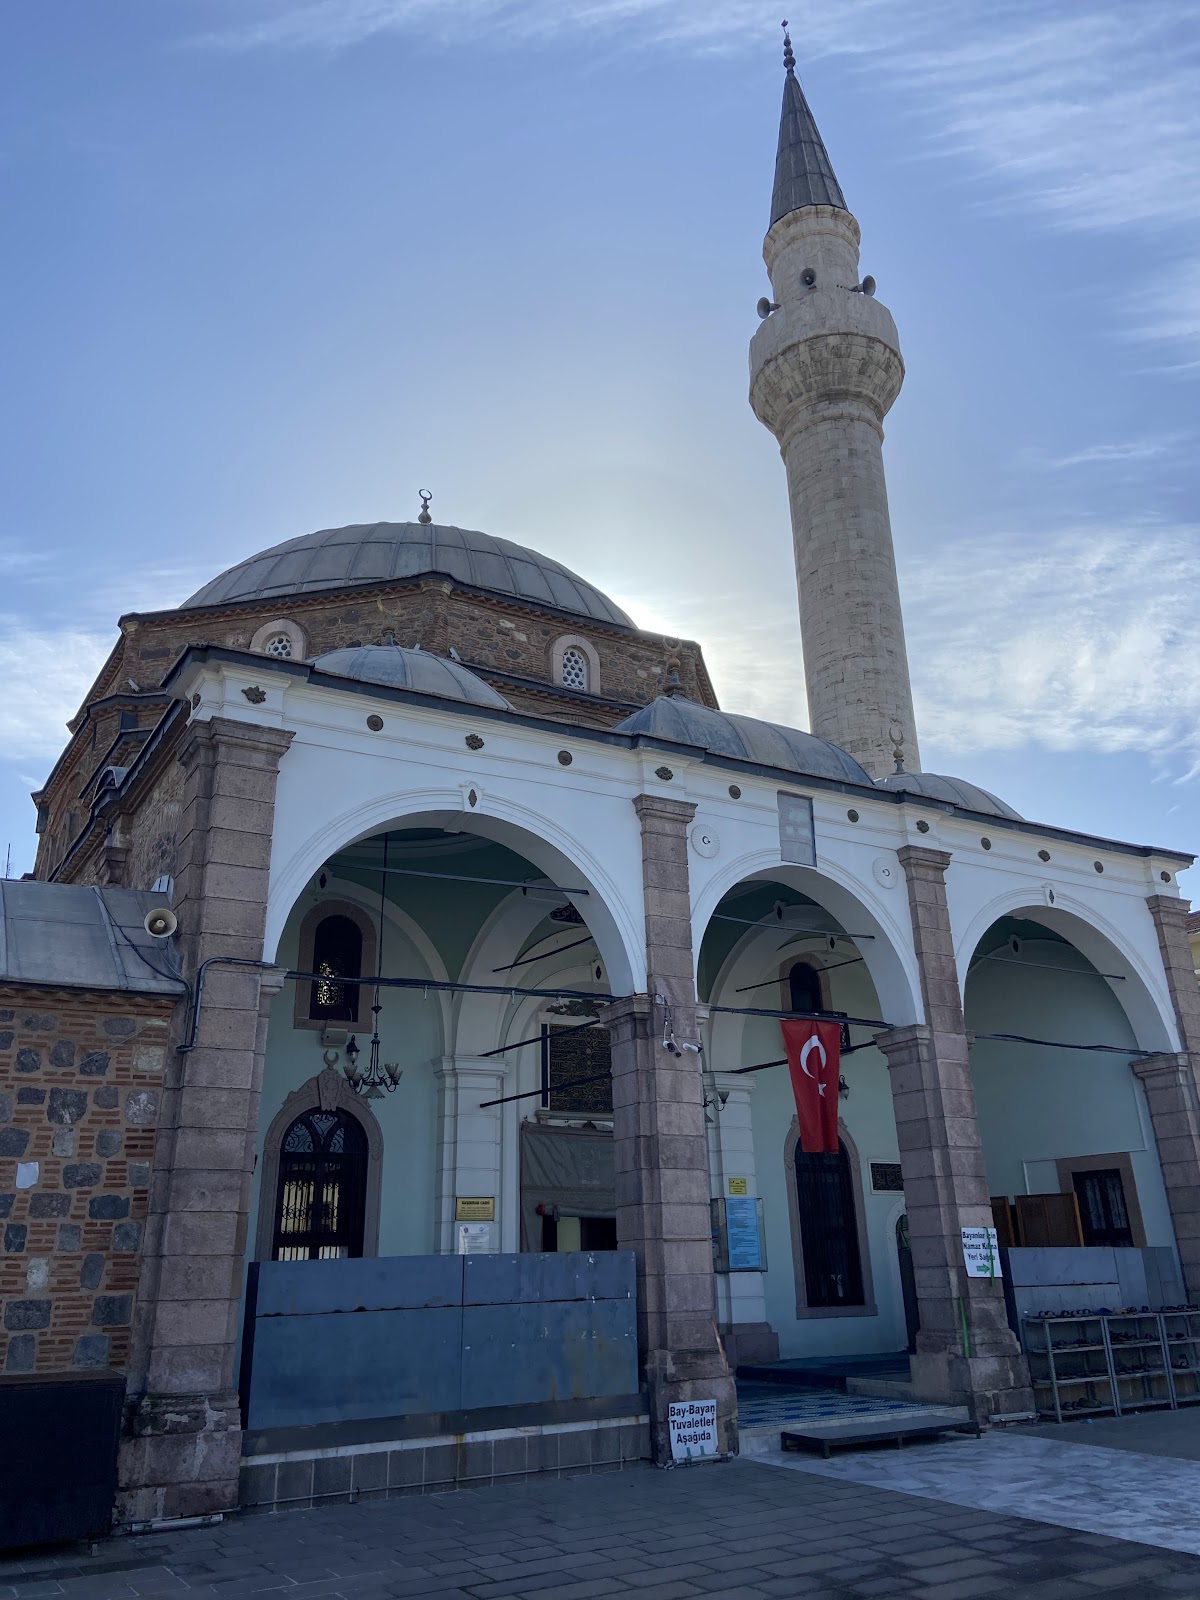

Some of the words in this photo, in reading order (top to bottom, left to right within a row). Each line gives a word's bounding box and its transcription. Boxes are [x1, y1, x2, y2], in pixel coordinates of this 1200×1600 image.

[962, 1231, 985, 1240] Bayanlar
[963, 1242, 981, 1250] Namaz
[967, 1252, 978, 1260] Yeri
[979, 1252, 996, 1262] Sağa
[670, 1404, 715, 1418] Bay-Bayan
[671, 1417, 715, 1430] Tuvaletler
[676, 1430, 711, 1445] Aşağıda
